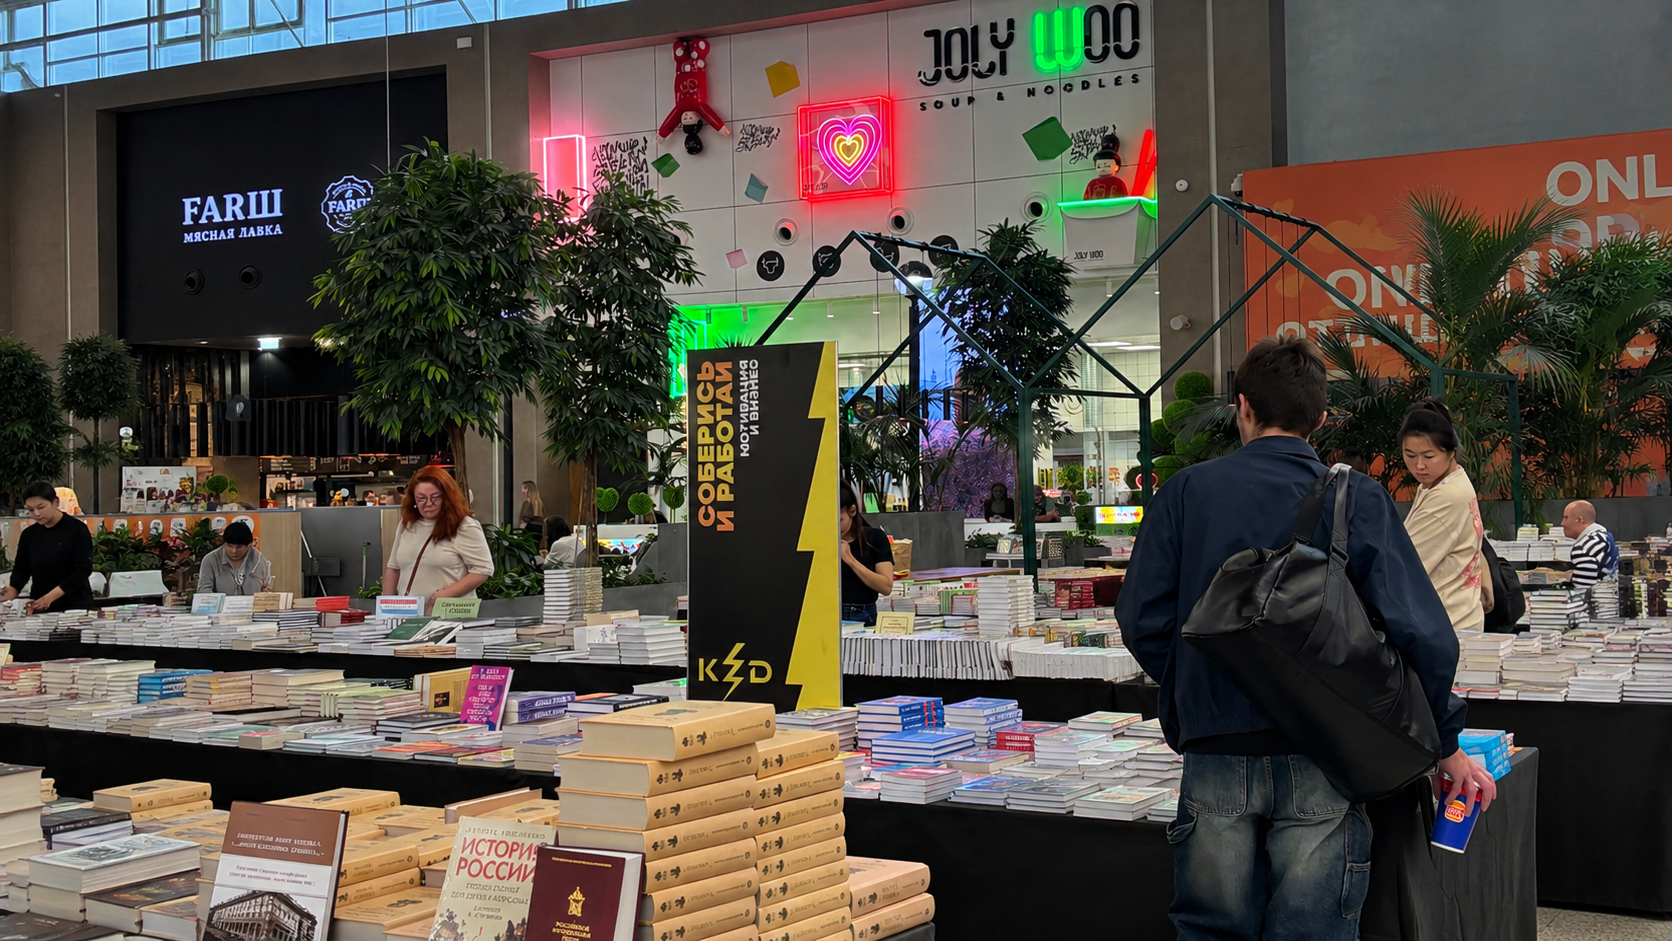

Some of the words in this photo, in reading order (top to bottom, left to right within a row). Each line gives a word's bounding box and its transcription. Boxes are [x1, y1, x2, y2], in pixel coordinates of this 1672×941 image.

[918, 18, 1014, 86] JOLY
[1035, 1, 1140, 72] WOO
[919, 96, 975, 111] SOUP
[996, 92, 1005, 101] &
[1027, 73, 1140, 97] NOODLES
[182, 188, 283, 226] FARШ
[183, 227, 235, 243] МЯСНАЯ
[238, 223, 283, 238] ЛАВКА
[697, 361, 715, 527] СОБЕРИСЬ
[716, 510, 735, 531] И
